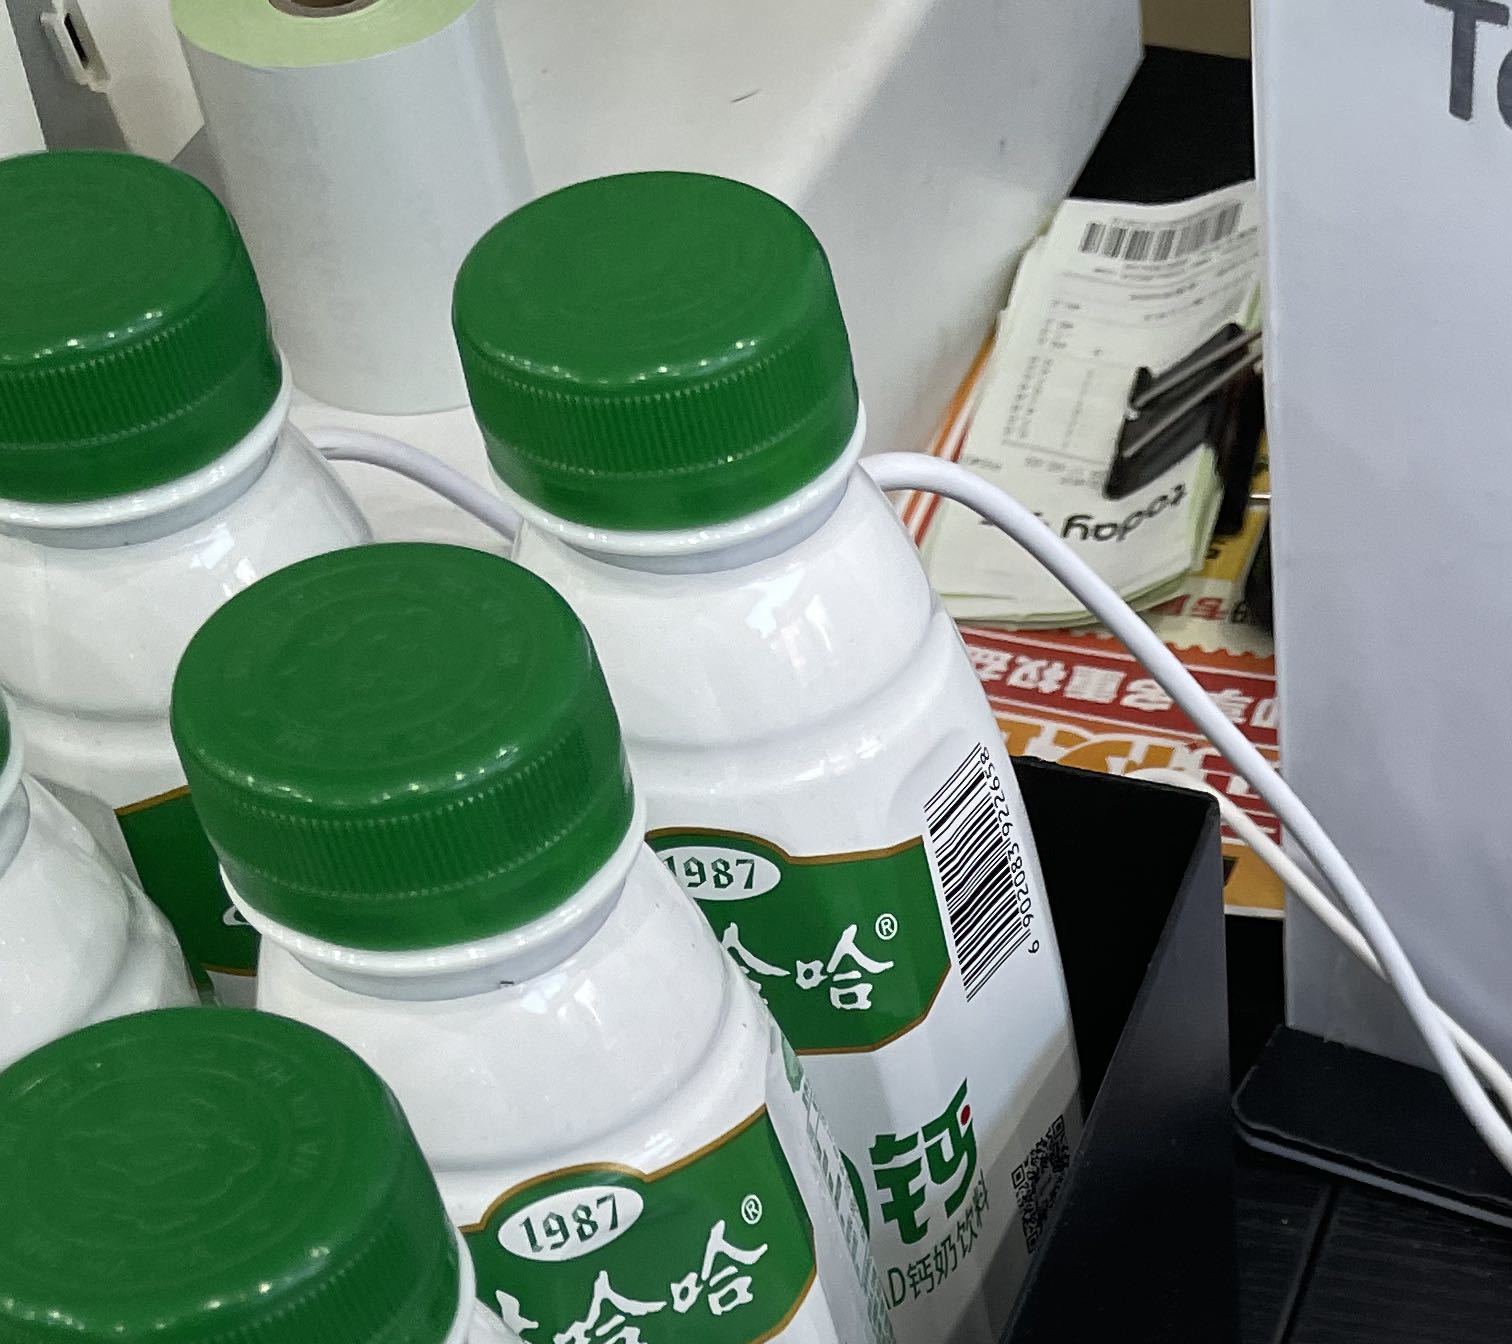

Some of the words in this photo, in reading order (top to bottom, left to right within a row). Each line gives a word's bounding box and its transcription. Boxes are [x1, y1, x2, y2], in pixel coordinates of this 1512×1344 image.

[979, 746, 1010, 837] 922658
[1008, 842, 1034, 928] 902083
[517, 1192, 620, 1254] 1987
[884, 1168, 990, 1311] D钙奶饮料
